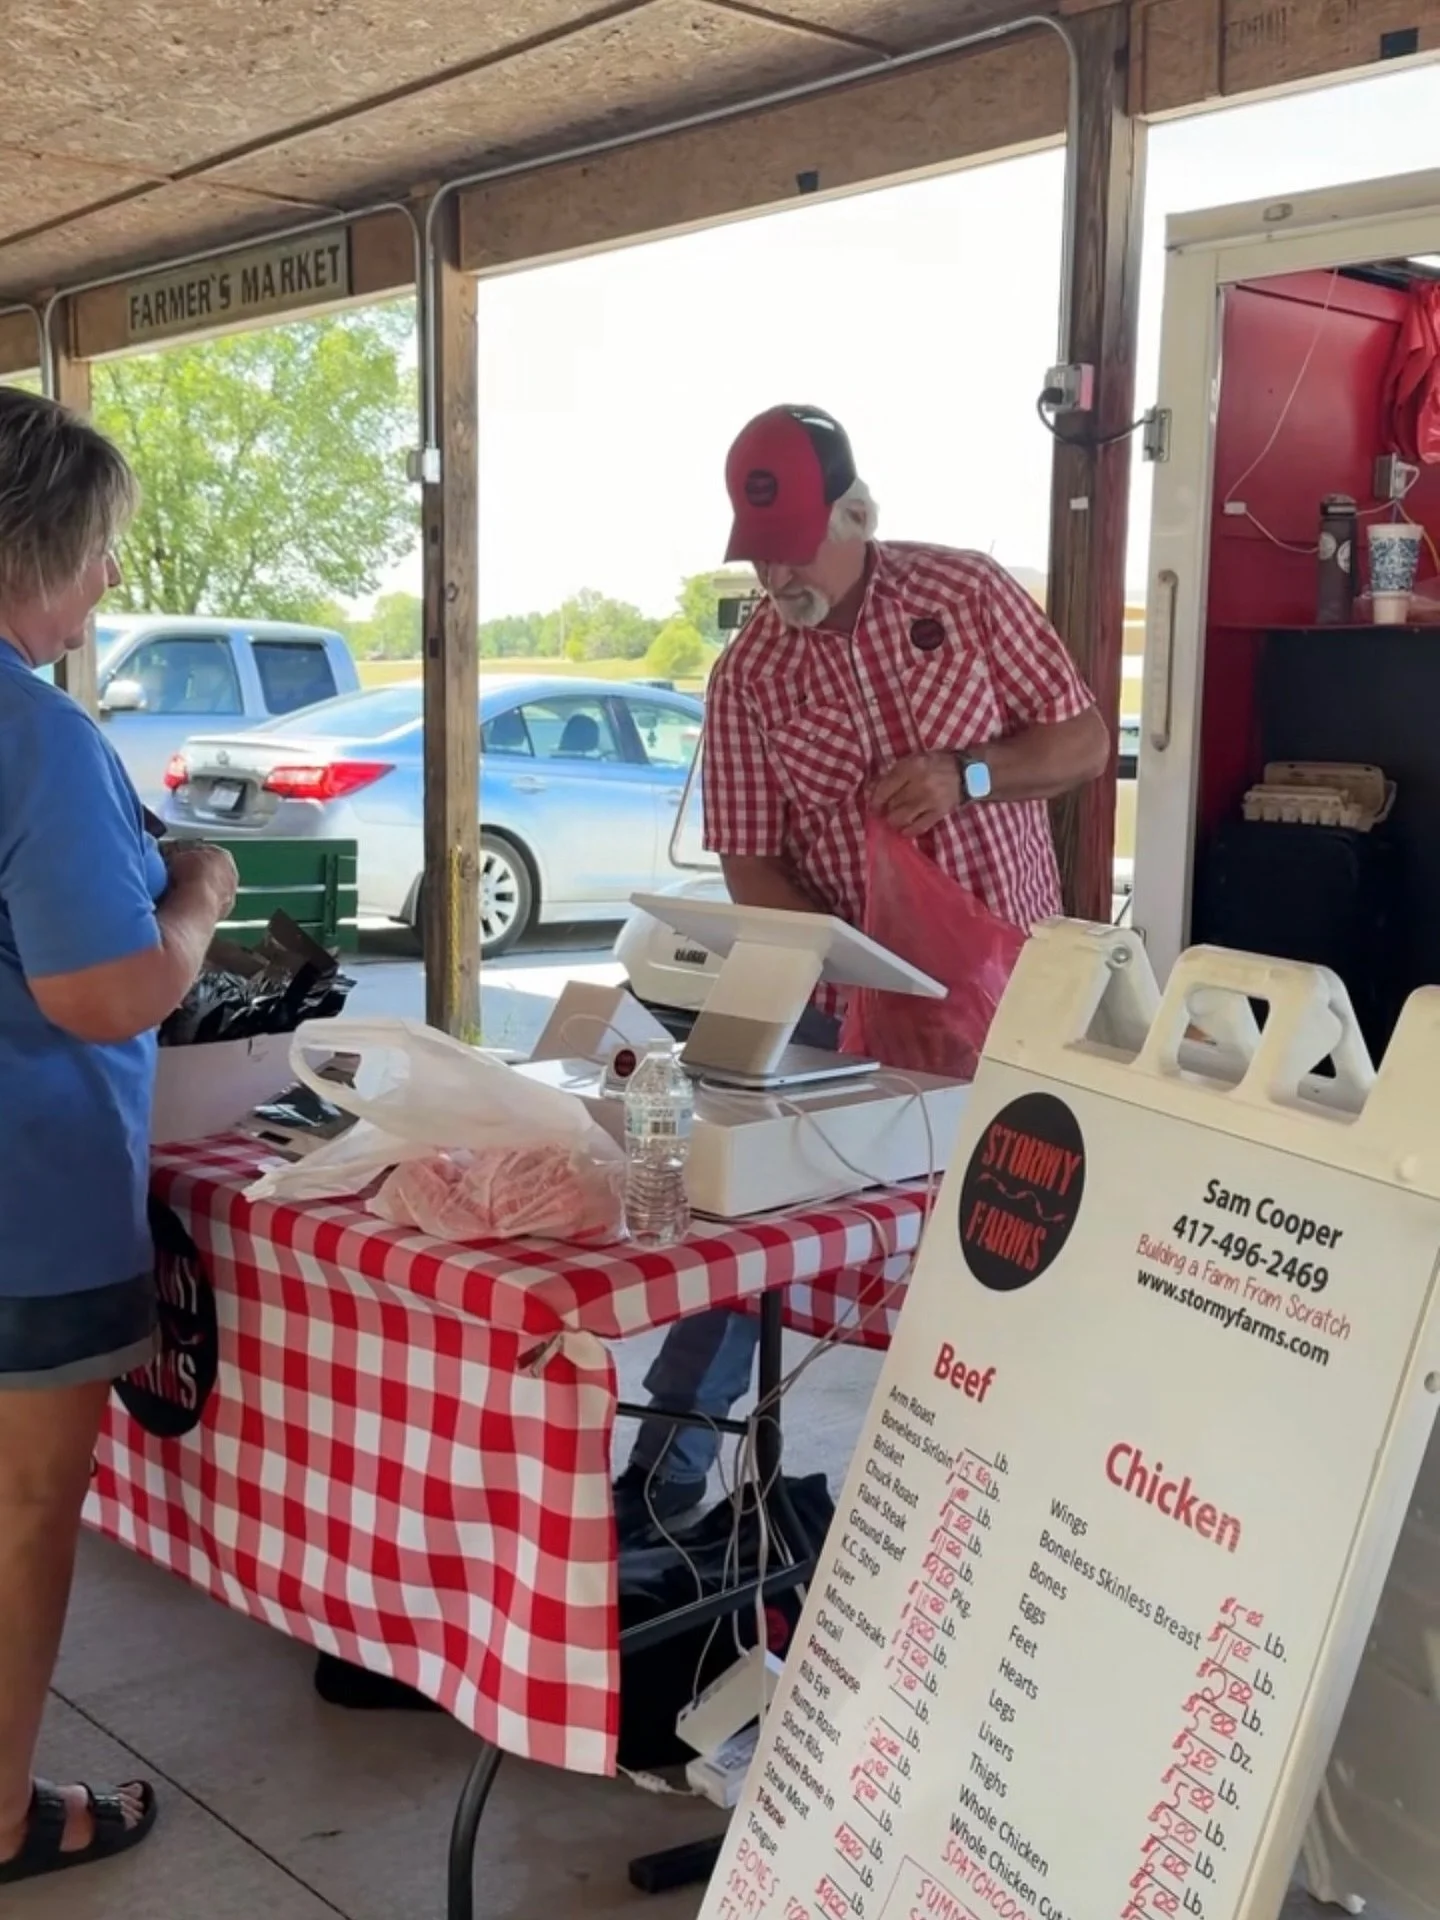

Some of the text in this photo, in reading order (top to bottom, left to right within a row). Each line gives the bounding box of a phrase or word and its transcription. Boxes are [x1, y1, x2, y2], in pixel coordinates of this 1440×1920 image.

[130, 244, 340, 330] FARMER'S MARKET
[981, 1123, 1082, 1196] STORMY
[966, 1200, 1047, 1271] FARMS
[1172, 1214, 1329, 1293] 417-496-2469
[1203, 1178, 1343, 1249] Sam Cooper
[1136, 1233, 1351, 1340] Building a Farm From Scratch
[1137, 1269, 1330, 1366] www.stormyfarms.com
[934, 1342, 996, 1403] Beef
[881, 1409, 922, 1448] Boneless
[921, 1436, 954, 1469] Sirloin
[986, 1480, 1000, 1502] Lb.
[889, 1385, 1009, 1475] Arm Roast Lb.
[865, 1458, 892, 1489] Chuck
[892, 1478, 919, 1508] Roast
[967, 1533, 982, 1557] Lb.
[873, 1433, 905, 1468] Brisket
[977, 1506, 991, 1531] Lb.
[1105, 1442, 1241, 1553] Chicken
[850, 1508, 884, 1545] Ground
[881, 1535, 906, 1562] Beef
[857, 1483, 881, 1511] Flank
[880, 1501, 907, 1532] Steak
[958, 1560, 974, 1586] Lb.
[1050, 1497, 1088, 1536] Wings
[1264, 1632, 1287, 1663] Lb.
[824, 1583, 857, 1621] Minute
[855, 1611, 887, 1649] Steaks
[924, 1670, 939, 1697] Lb.
[832, 1558, 856, 1586] Liver
[933, 1643, 948, 1669] Lb.
[858, 1547, 880, 1578] Strip
[941, 1615, 957, 1640] Lb.
[1039, 1529, 1096, 1581] Boneless
[1095, 1568, 1153, 1618] Skinless
[1153, 1605, 1202, 1651] Breast
[1253, 1668, 1275, 1700] Lb.
[816, 1609, 845, 1643] Oxtail
[915, 1698, 929, 1725] Lb.
[1019, 1592, 1047, 1626] Eggs
[1229, 1742, 1253, 1774] Dz.
[1029, 1561, 1068, 1601] Bones
[1241, 1708, 1264, 1737] Lb.
[791, 1684, 903, 1809] Rump Roast Lb.
[799, 1659, 815, 1684] Rib
[813, 1673, 831, 1700] Eye
[897, 1754, 912, 1780] Lb.
[905, 1725, 921, 1753] Lb.
[998, 1656, 1039, 1700] Hearts
[1205, 1818, 1227, 1851] Lb.
[1008, 1624, 1038, 1659] Feet
[1217, 1777, 1240, 1810] Lb.
[782, 1710, 806, 1744] Short
[804, 1734, 825, 1765] Ribs
[878, 1808, 893, 1837] Lb.
[969, 1751, 1008, 1799] Thighs
[977, 1720, 1015, 1763] Livers
[1183, 1887, 1204, 1920] Lb.
[988, 1688, 1016, 1723] Legs
[1195, 1851, 1217, 1884] Lb.
[748, 1810, 779, 1856] Tongue
[764, 1760, 787, 1793] Stew
[785, 1784, 810, 1820] Meat
[860, 1864, 875, 1892] Lb.
[869, 1837, 884, 1864] Lb.
[950, 1813, 987, 1860] Whole
[988, 1850, 1037, 1907] Chicken
[959, 1783, 1049, 1878] Whole Chicken
